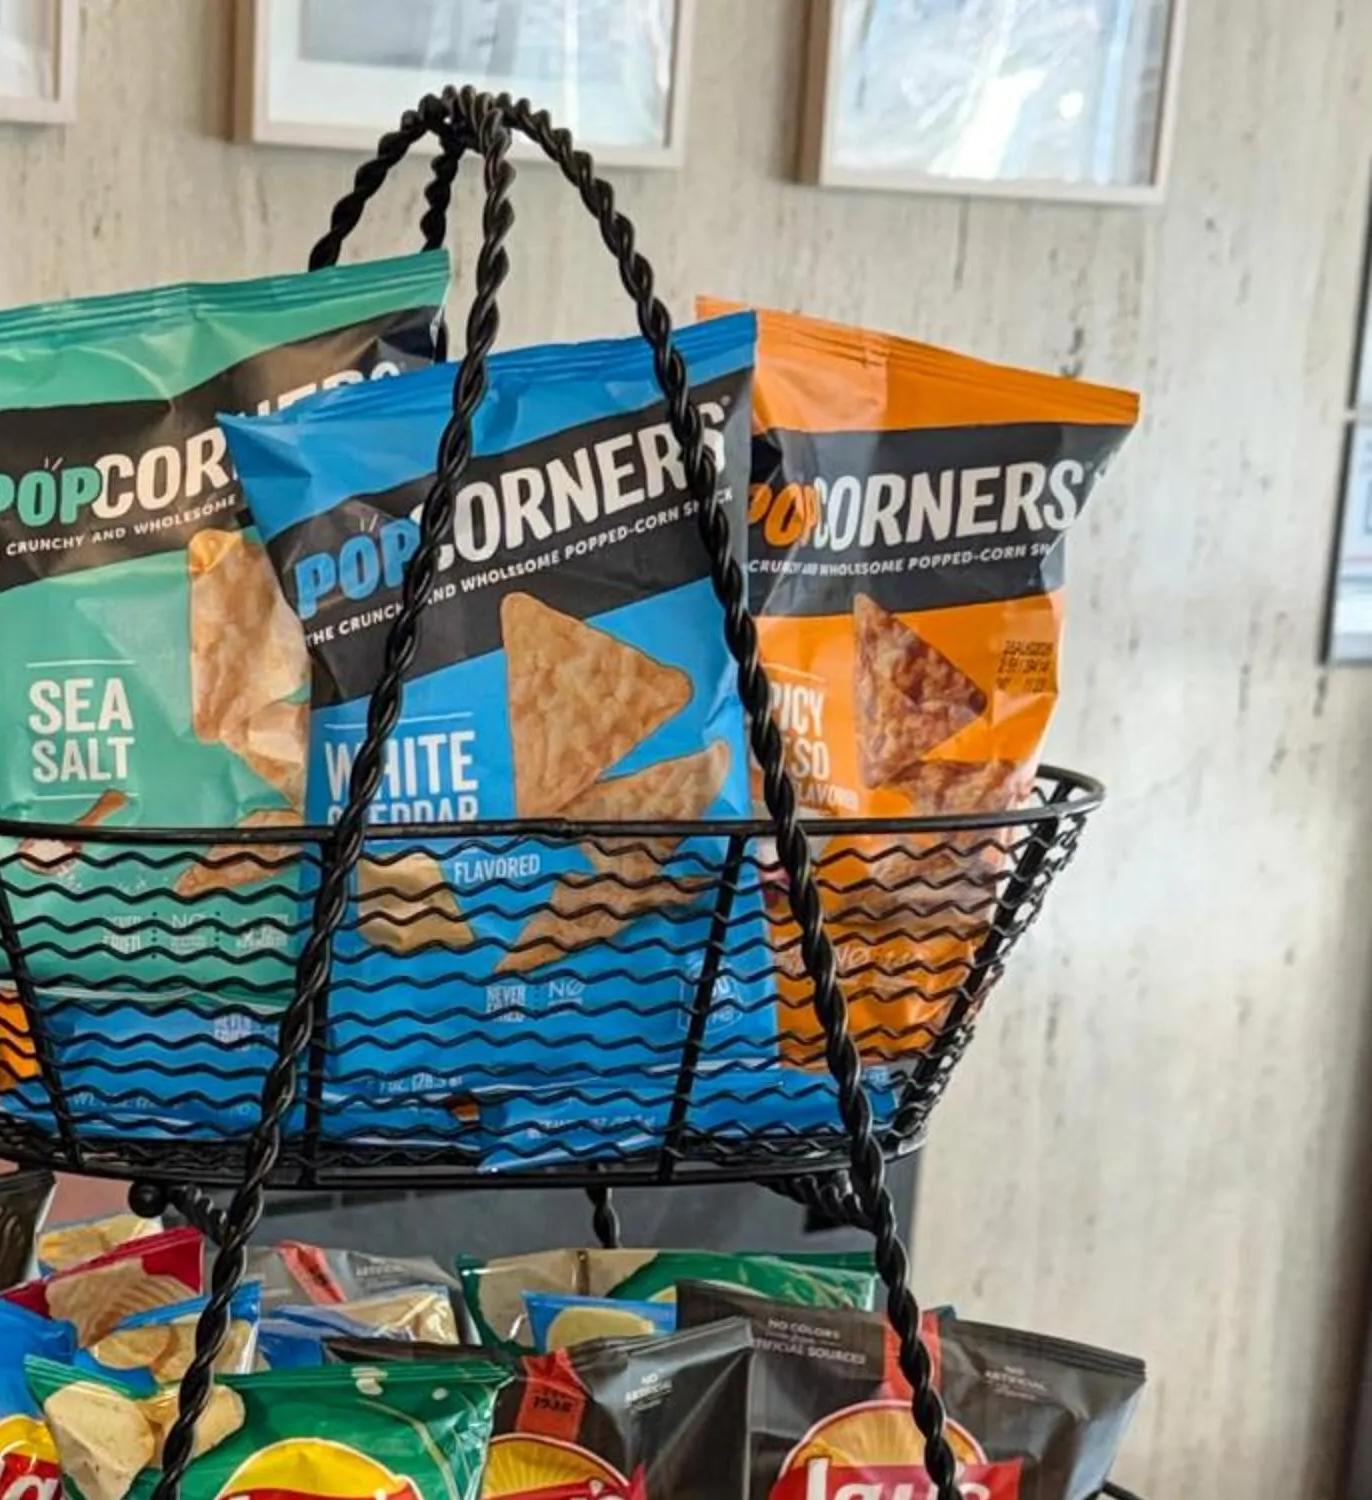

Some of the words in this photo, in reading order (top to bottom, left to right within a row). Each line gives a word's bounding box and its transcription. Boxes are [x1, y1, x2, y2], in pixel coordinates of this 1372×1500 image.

[5, 533, 85, 557] CRUNCHY
[92, 525, 127, 544] AND
[133, 493, 236, 537] WHOLESOME
[908, 543, 1027, 570] POPPED-CORN
[305, 626, 335, 647] THE
[427, 582, 457, 605] ND
[461, 549, 561, 596] WHOLESOME
[564, 507, 681, 562] POPPED-CORN
[29, 677, 133, 734] SEA
[32, 736, 136, 784] SALT
[454, 852, 541, 885] FLAVORED
[768, 1318, 788, 1332] NO
[790, 1322, 840, 1341] COLORS
[808, 1346, 867, 1365] SOURCES
